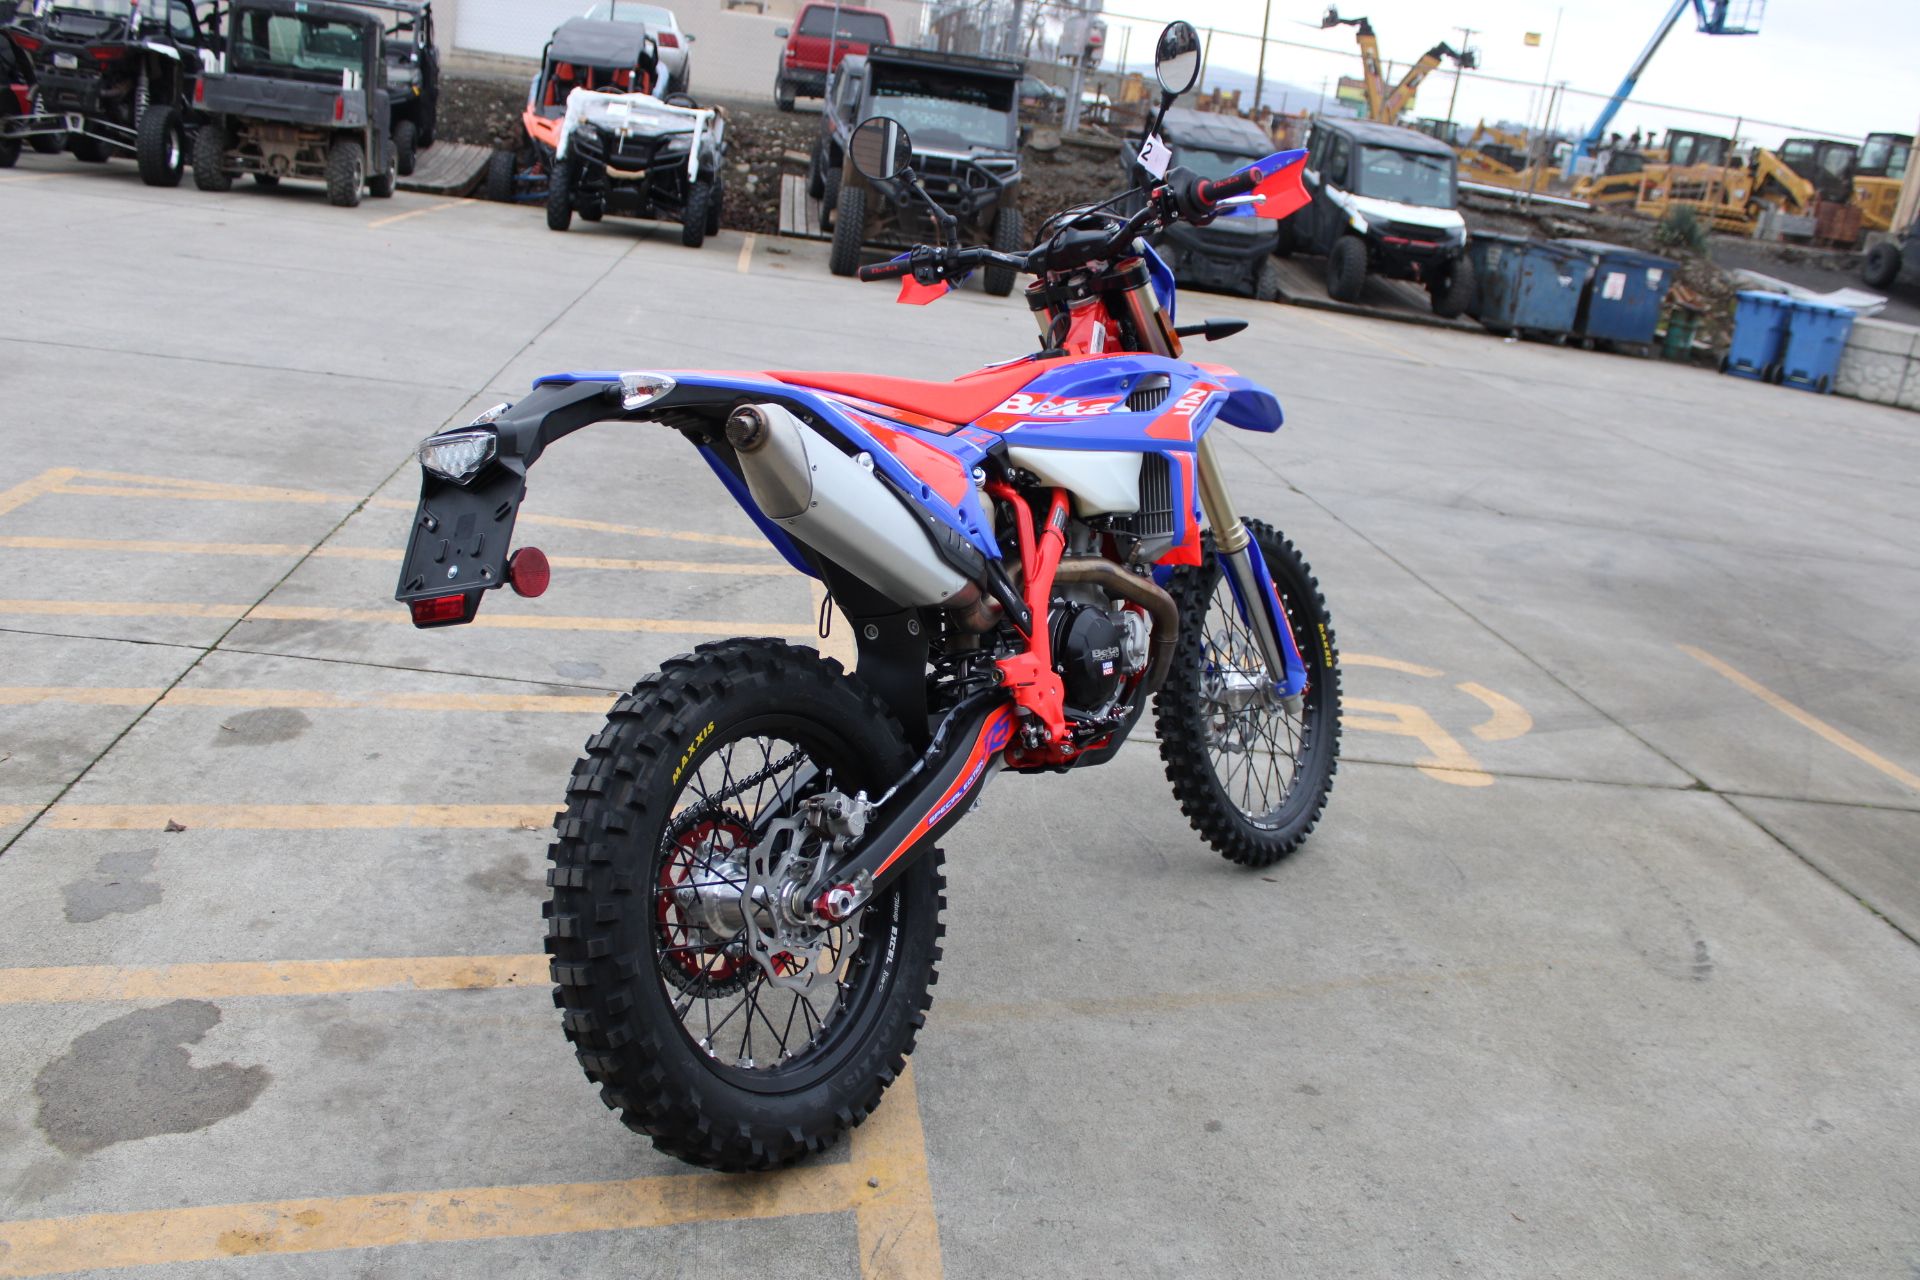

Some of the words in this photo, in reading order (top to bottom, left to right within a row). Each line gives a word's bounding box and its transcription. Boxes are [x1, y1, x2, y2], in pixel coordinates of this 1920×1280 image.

[991, 393, 1111, 415] Beta
[1092, 646, 1119, 657] Beta
[1318, 623, 1332, 667] MAXXIS
[673, 721, 715, 785] MAXXIS
[928, 790, 963, 825] SPECIAL
[963, 758, 985, 790] EDITION
[886, 925, 898, 964] EXCEL
